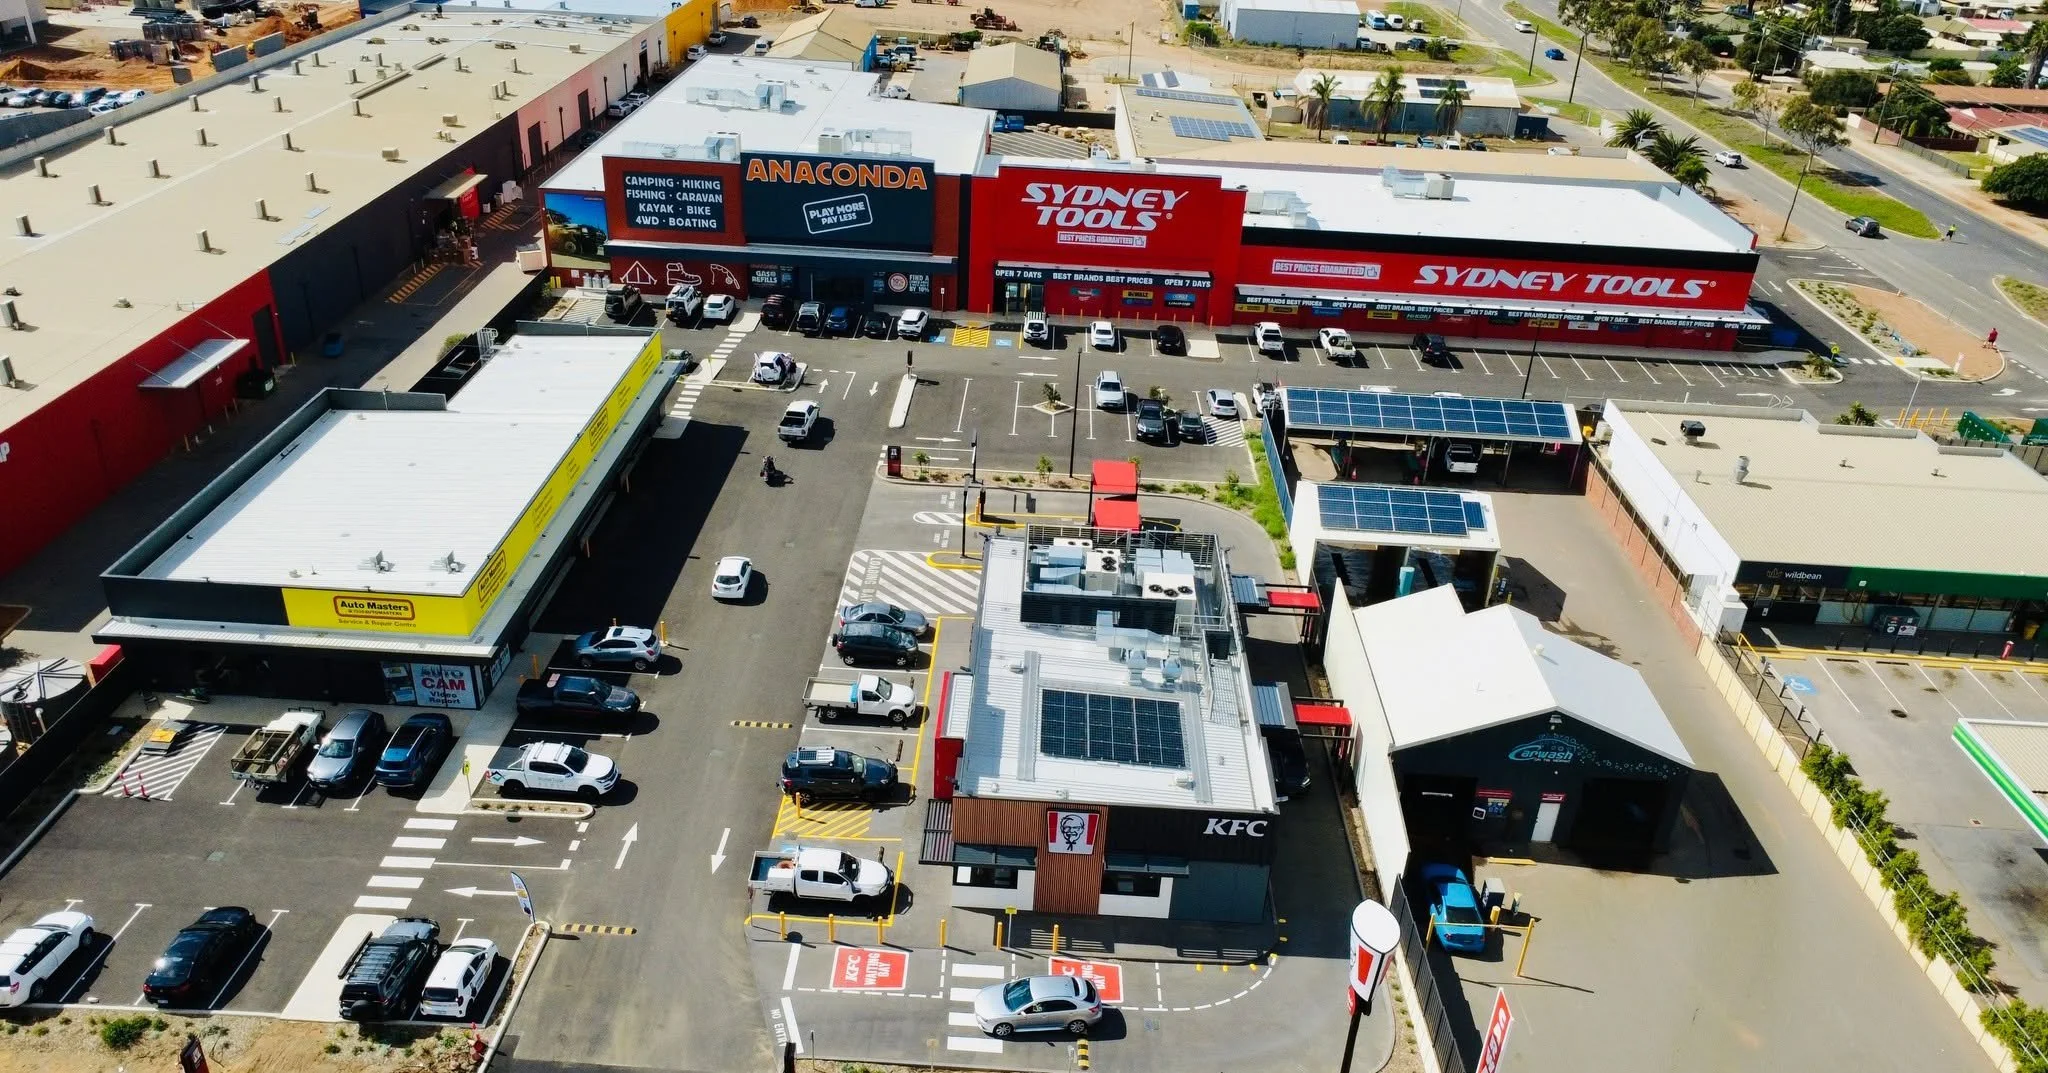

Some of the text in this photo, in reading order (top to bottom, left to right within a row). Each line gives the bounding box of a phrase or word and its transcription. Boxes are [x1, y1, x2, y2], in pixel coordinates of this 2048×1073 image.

[746, 158, 927, 190] ANACONDA
[625, 176, 720, 190] CAMPING HIKING
[626, 189, 723, 203] FISHING CARAVAN
[1021, 183, 1189, 210] SYDNEY
[638, 203, 711, 215] KAYAK BIKE
[809, 202, 866, 219] PLAY MORE
[635, 216, 717, 228] 4WD BOATING
[821, 212, 857, 225] PAY LESS
[1036, 206, 1162, 231] TOOLS
[1060, 233, 1133, 245] BEST PRICES GUARANTEED
[995, 269, 1014, 277] OPEN
[1023, 271, 1042, 279] DAYS
[1275, 262, 1365, 275] BEST PRICES GUARANTEED
[1053, 272, 1153, 285] BEST BRANDS BEST PRICES
[1185, 279, 1190, 287] 7
[1192, 280, 1211, 288] DAYS
[1414, 265, 1709, 299] SYDNEY TOOLS
[1262, 297, 1286, 305] BRANDS
[1302, 299, 1322, 307] PRICES
[1392, 304, 1416, 312] BRANDS
[1433, 306, 1454, 314] PRICES
[1654, 318, 1678, 326] BRANDS
[1678, 319, 1693, 327] BEST
[1693, 320, 1714, 328] PRICES
[864, 557, 882, 585] LOADING
[1785, 571, 1822, 580] wildbean
[340, 600, 409, 611] Auto Masters
[421, 677, 466, 691] CAM
[429, 697, 461, 705] Report
[1203, 818, 1268, 837] KFC
[845, 954, 861, 983] KFC
[864, 952, 880, 986] WAITING
[877, 961, 891, 977] BAY
[770, 1008, 782, 1019] NO
